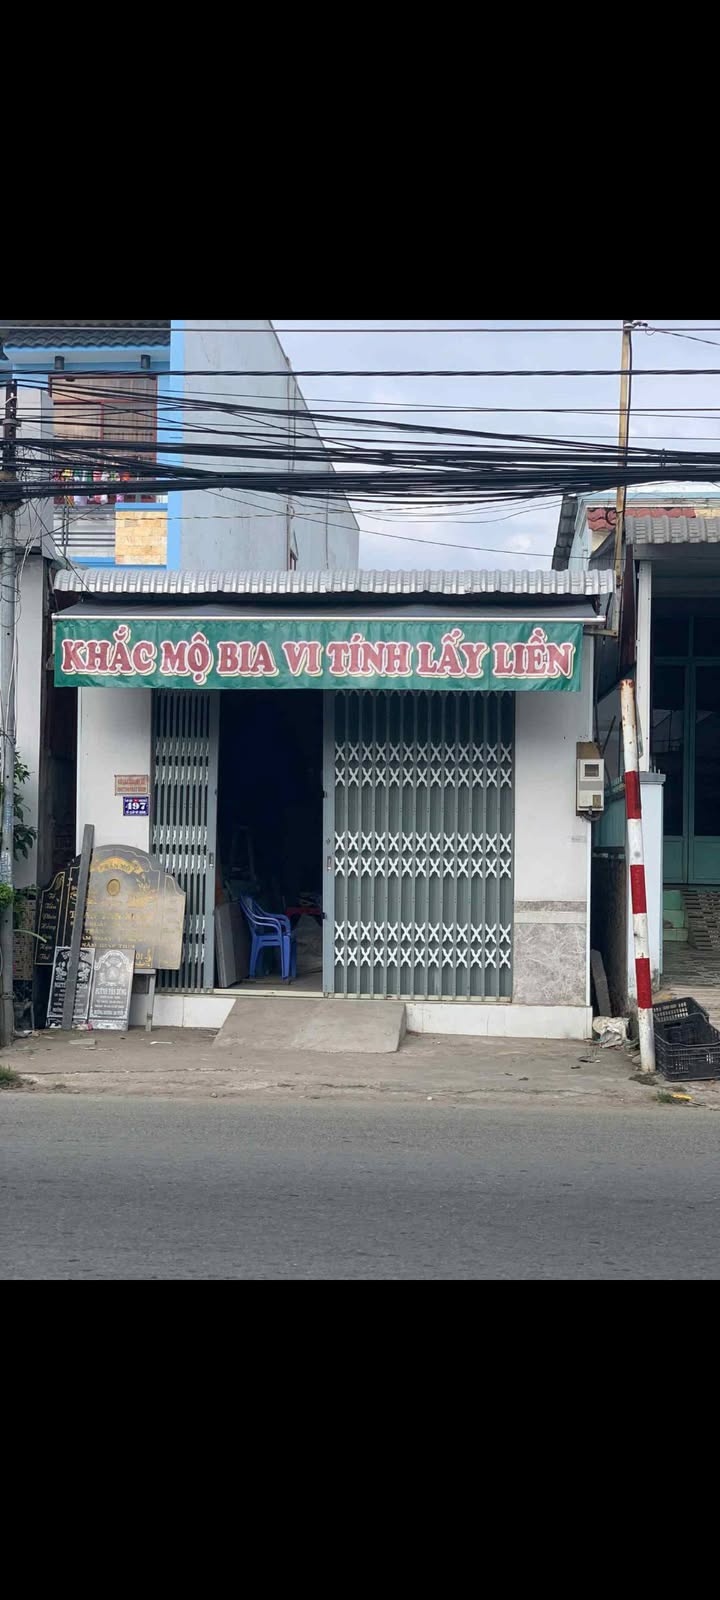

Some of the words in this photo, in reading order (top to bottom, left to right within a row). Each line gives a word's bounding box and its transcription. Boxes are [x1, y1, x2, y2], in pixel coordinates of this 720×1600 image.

[61, 624, 157, 676] KHẮC
[160, 631, 213, 685] MỘ
[217, 641, 280, 677] BIA
[283, 642, 323, 677] VI
[326, 633, 413, 678] TÍNH
[416, 628, 490, 679] LẤY
[492, 627, 576, 679] LIỀN
[125, 802, 147, 811] 497
